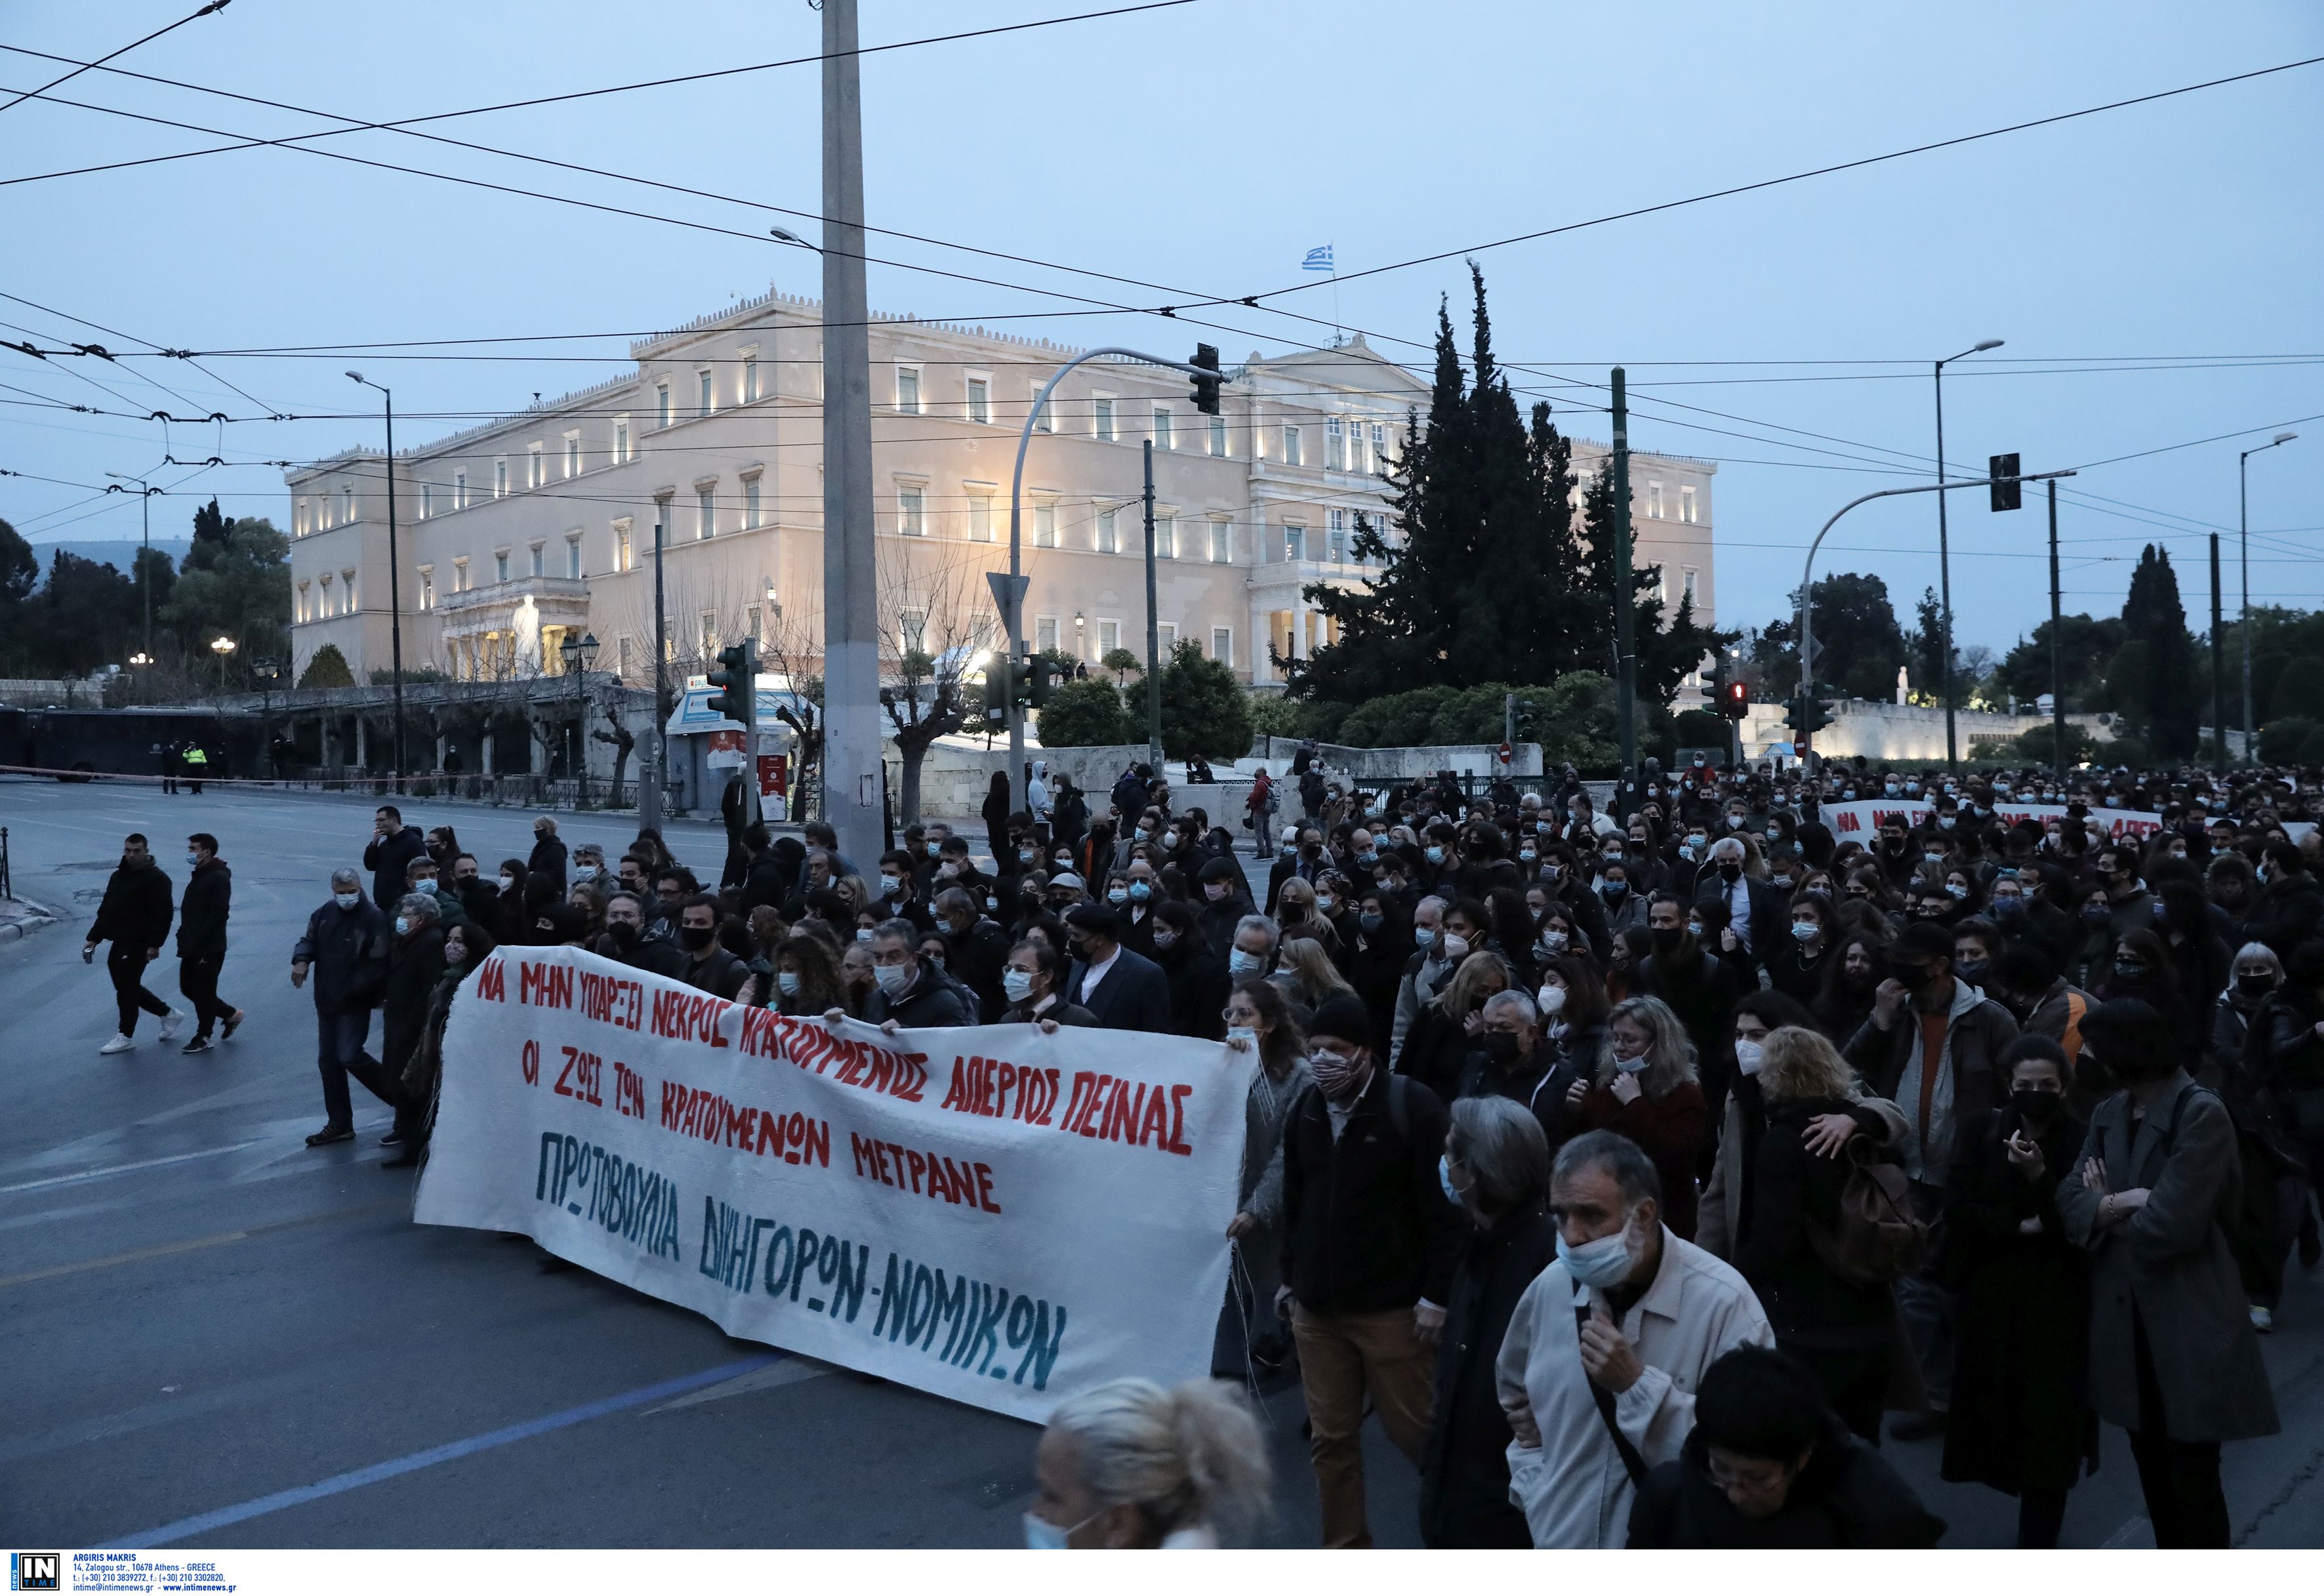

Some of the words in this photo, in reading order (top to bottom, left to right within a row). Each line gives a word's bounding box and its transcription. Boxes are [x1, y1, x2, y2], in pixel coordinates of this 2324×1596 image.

[477, 958, 506, 1003] ΝΑ
[520, 961, 574, 1009] ΜΗΝ
[580, 971, 643, 1032] ΥΠΑΡΞΕΙ
[651, 989, 733, 1048] ΝΕΚΡΟΣ
[740, 1005, 928, 1103] ΚΡΑΤΟΥΜΕΝΟΣ
[941, 1055, 1061, 1126] ΑΠΕΡΓΟΣ
[1059, 1071, 1193, 1156] ΠΕΙΝΑΣ
[522, 1039, 539, 1087] ΟΙ
[614, 1061, 644, 1120] ΤΩΝ
[662, 1080, 830, 1168] ΚΡΑΤΟΥΜΕΝΩΝ
[851, 1132, 1002, 1215] ΜΕΤΡΑΝΕ
[536, 1132, 681, 1262] ΠΡΩΤΟΒΟΥΛΙΑ
